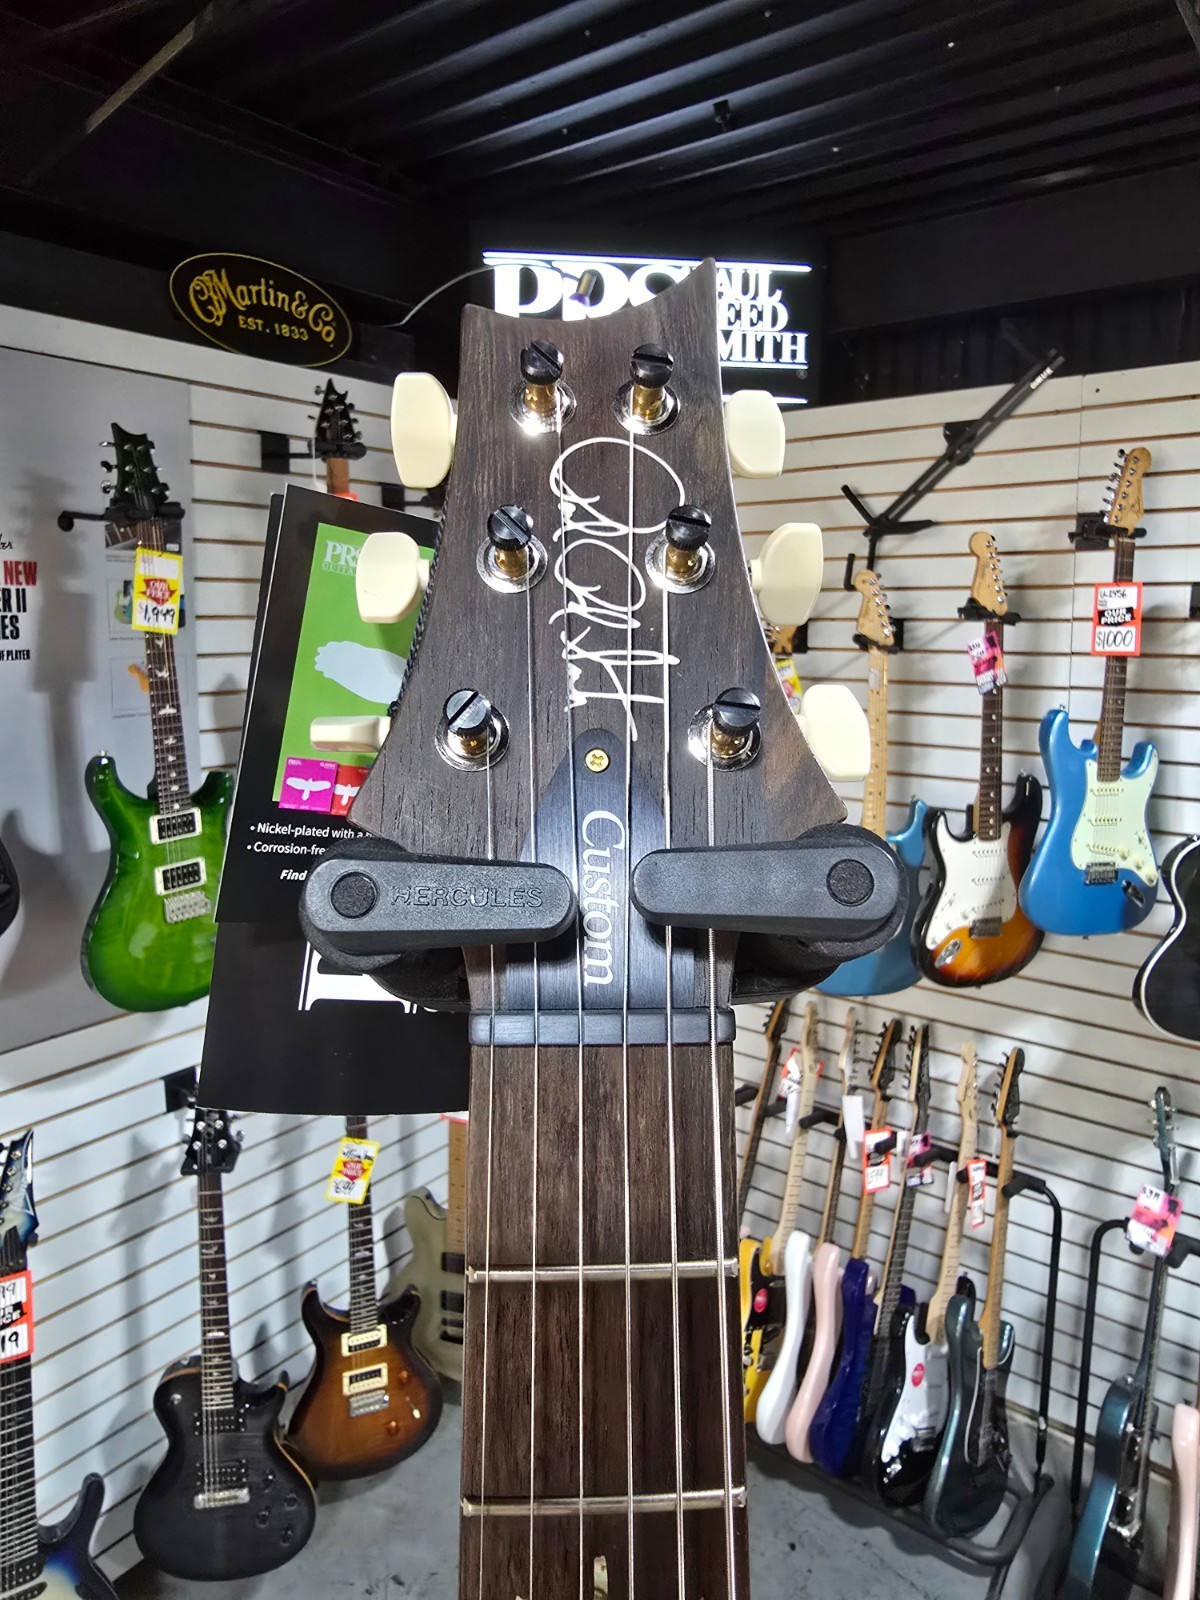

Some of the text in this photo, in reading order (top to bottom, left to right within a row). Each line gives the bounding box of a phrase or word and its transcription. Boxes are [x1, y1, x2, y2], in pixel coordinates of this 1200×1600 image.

[716, 267, 782, 301] AUL
[718, 300, 788, 332] EED
[274, 322, 309, 341] 1833
[719, 331, 808, 363] MITH
[3, 560, 38, 587] NEW
[322, 561, 357, 577] GUITA
[1101, 613, 1133, 625] PRICE
[1104, 608, 1127, 618] OUR
[1096, 630, 1133, 649] $1000
[257, 822, 330, 838] Nickel-plated
[331, 827, 355, 839] with
[253, 841, 327, 855] Corrosion-fre
[279, 869, 308, 881] Find
[391, 885, 544, 908] HERCULES
[582, 810, 626, 987] Custom
